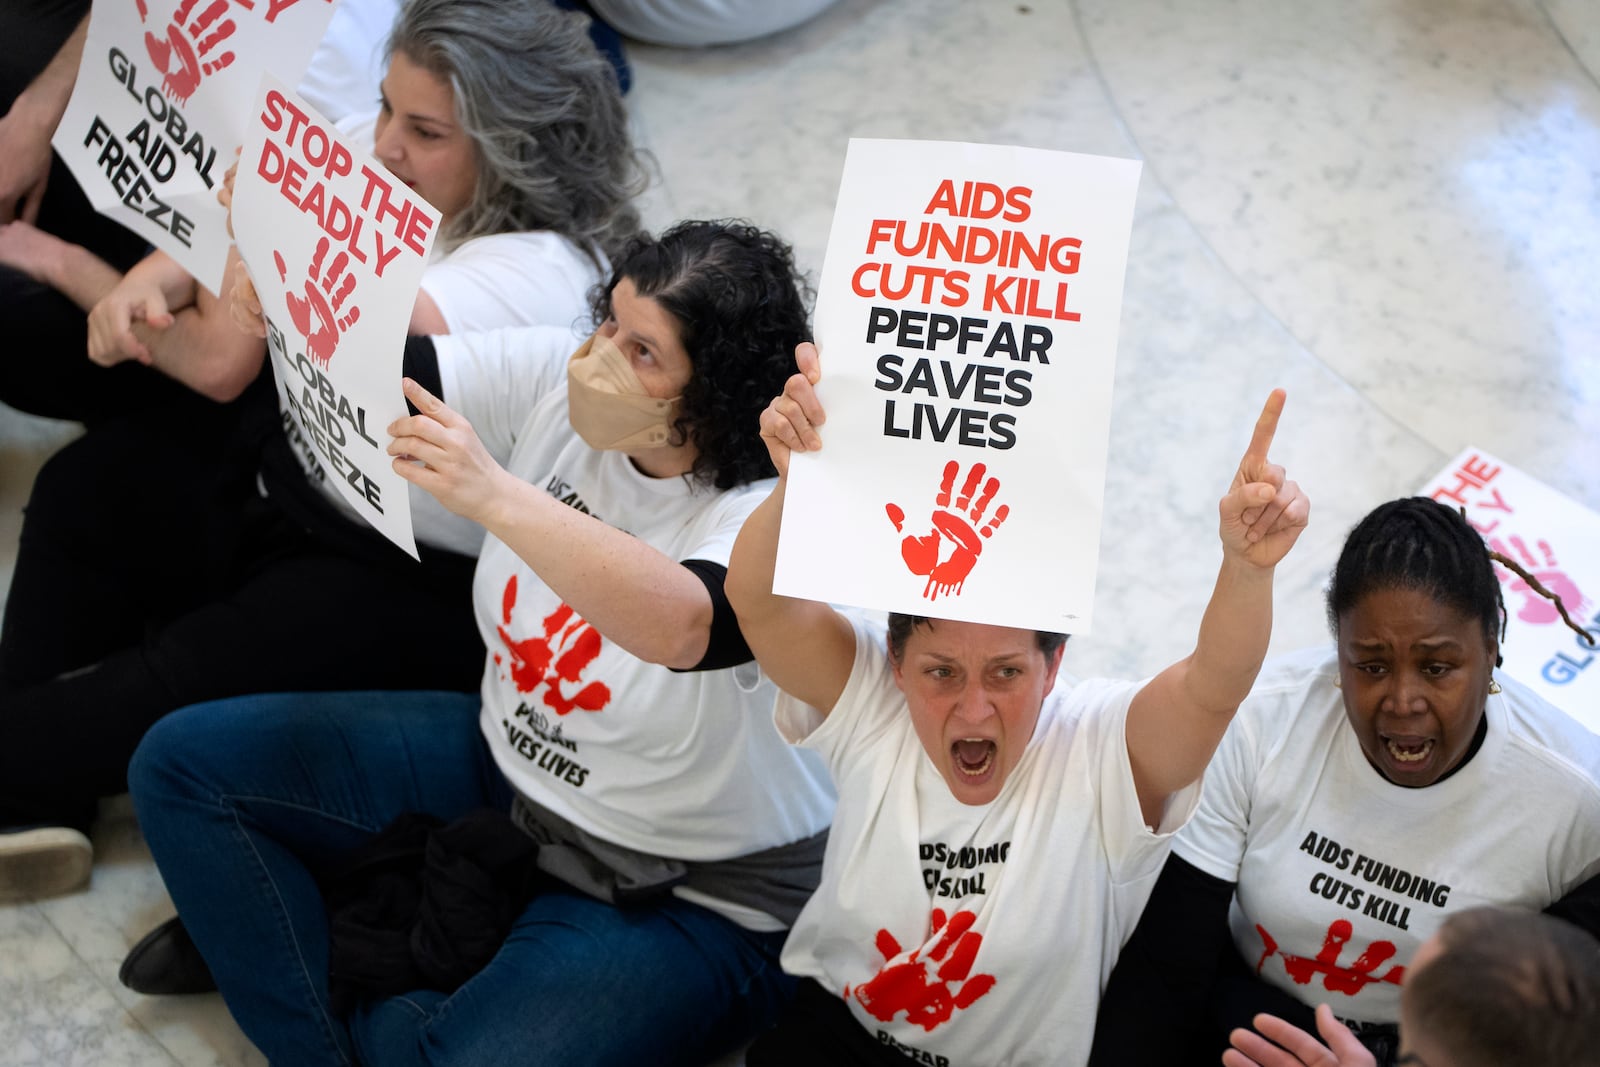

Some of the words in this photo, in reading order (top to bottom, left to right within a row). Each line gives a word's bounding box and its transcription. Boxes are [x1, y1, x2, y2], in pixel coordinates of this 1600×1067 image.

[108, 46, 217, 190] GLOBAL
[83, 115, 196, 249] FREEZE
[126, 118, 177, 184] AID
[260, 89, 353, 181] STOP
[361, 164, 434, 257] THE
[257, 137, 402, 278] DEADLY
[924, 179, 1033, 223] AIDS
[866, 219, 1083, 275] FUNDING
[851, 262, 971, 308] CUTS
[983, 273, 1081, 322] KILL
[866, 306, 1053, 364] PEPFAR
[266, 315, 379, 450] GLOBAL
[874, 354, 1033, 407] SAVES
[302, 385, 347, 447] AID
[883, 400, 1017, 450] LIVES
[284, 380, 385, 515] FREEZE
[1431, 454, 1502, 504] HE
[1541, 608, 1600, 686] GLO
[537, 748, 590, 787] LIVES
[1299, 830, 1354, 870] AIDS
[1351, 854, 1451, 908] FUNDING
[1309, 872, 1365, 910] CUTS
[1362, 893, 1411, 931] KILL
